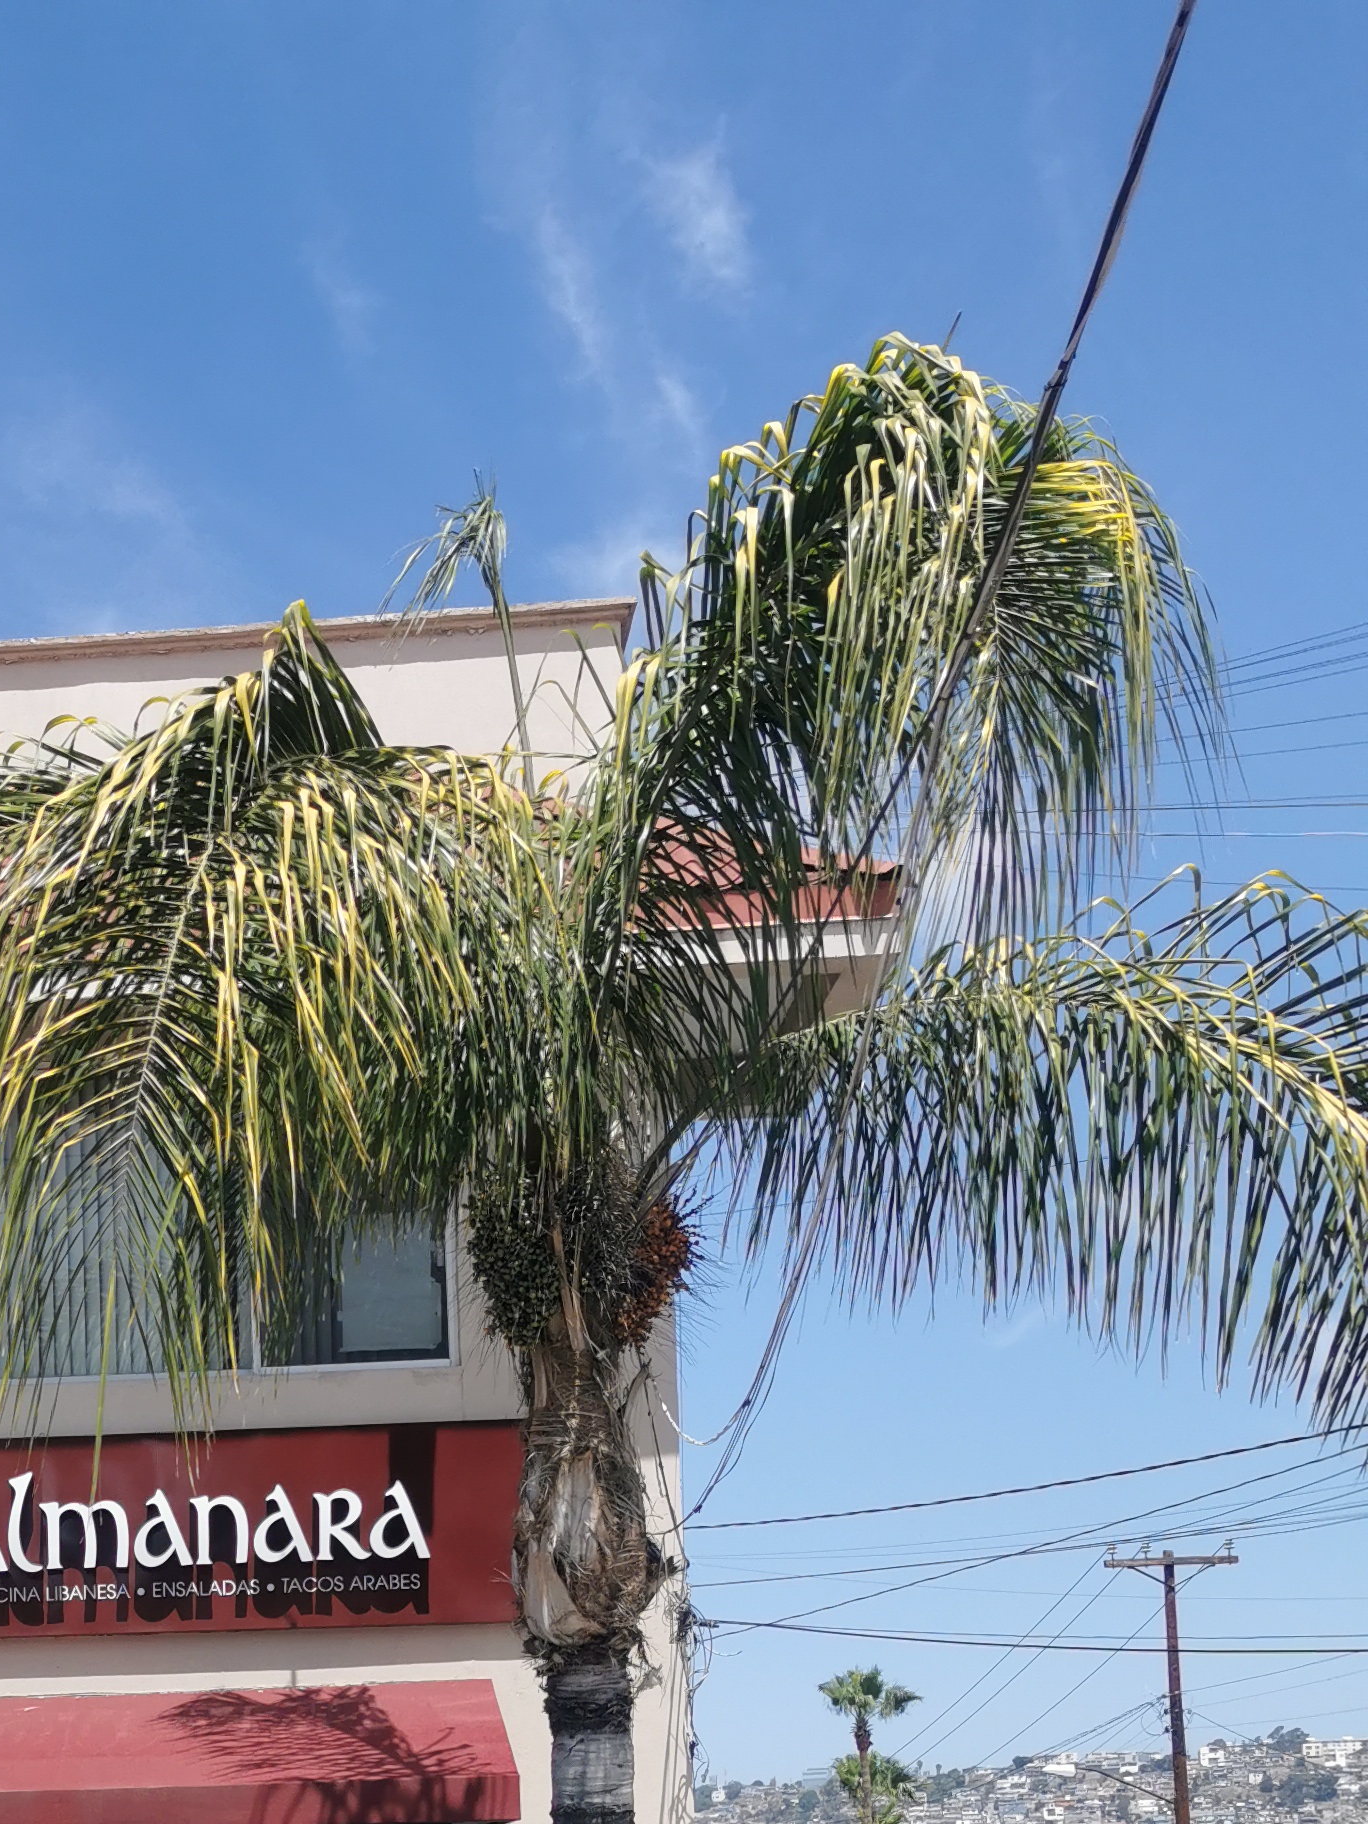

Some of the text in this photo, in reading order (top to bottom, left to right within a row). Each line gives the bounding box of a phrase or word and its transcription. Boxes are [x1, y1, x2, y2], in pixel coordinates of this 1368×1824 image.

[45, 1582, 131, 1602] LIBANESA
[152, 1578, 261, 1599] ENSALADAS
[281, 1574, 344, 1594] TACOS
[349, 1573, 421, 1592] ARABES
